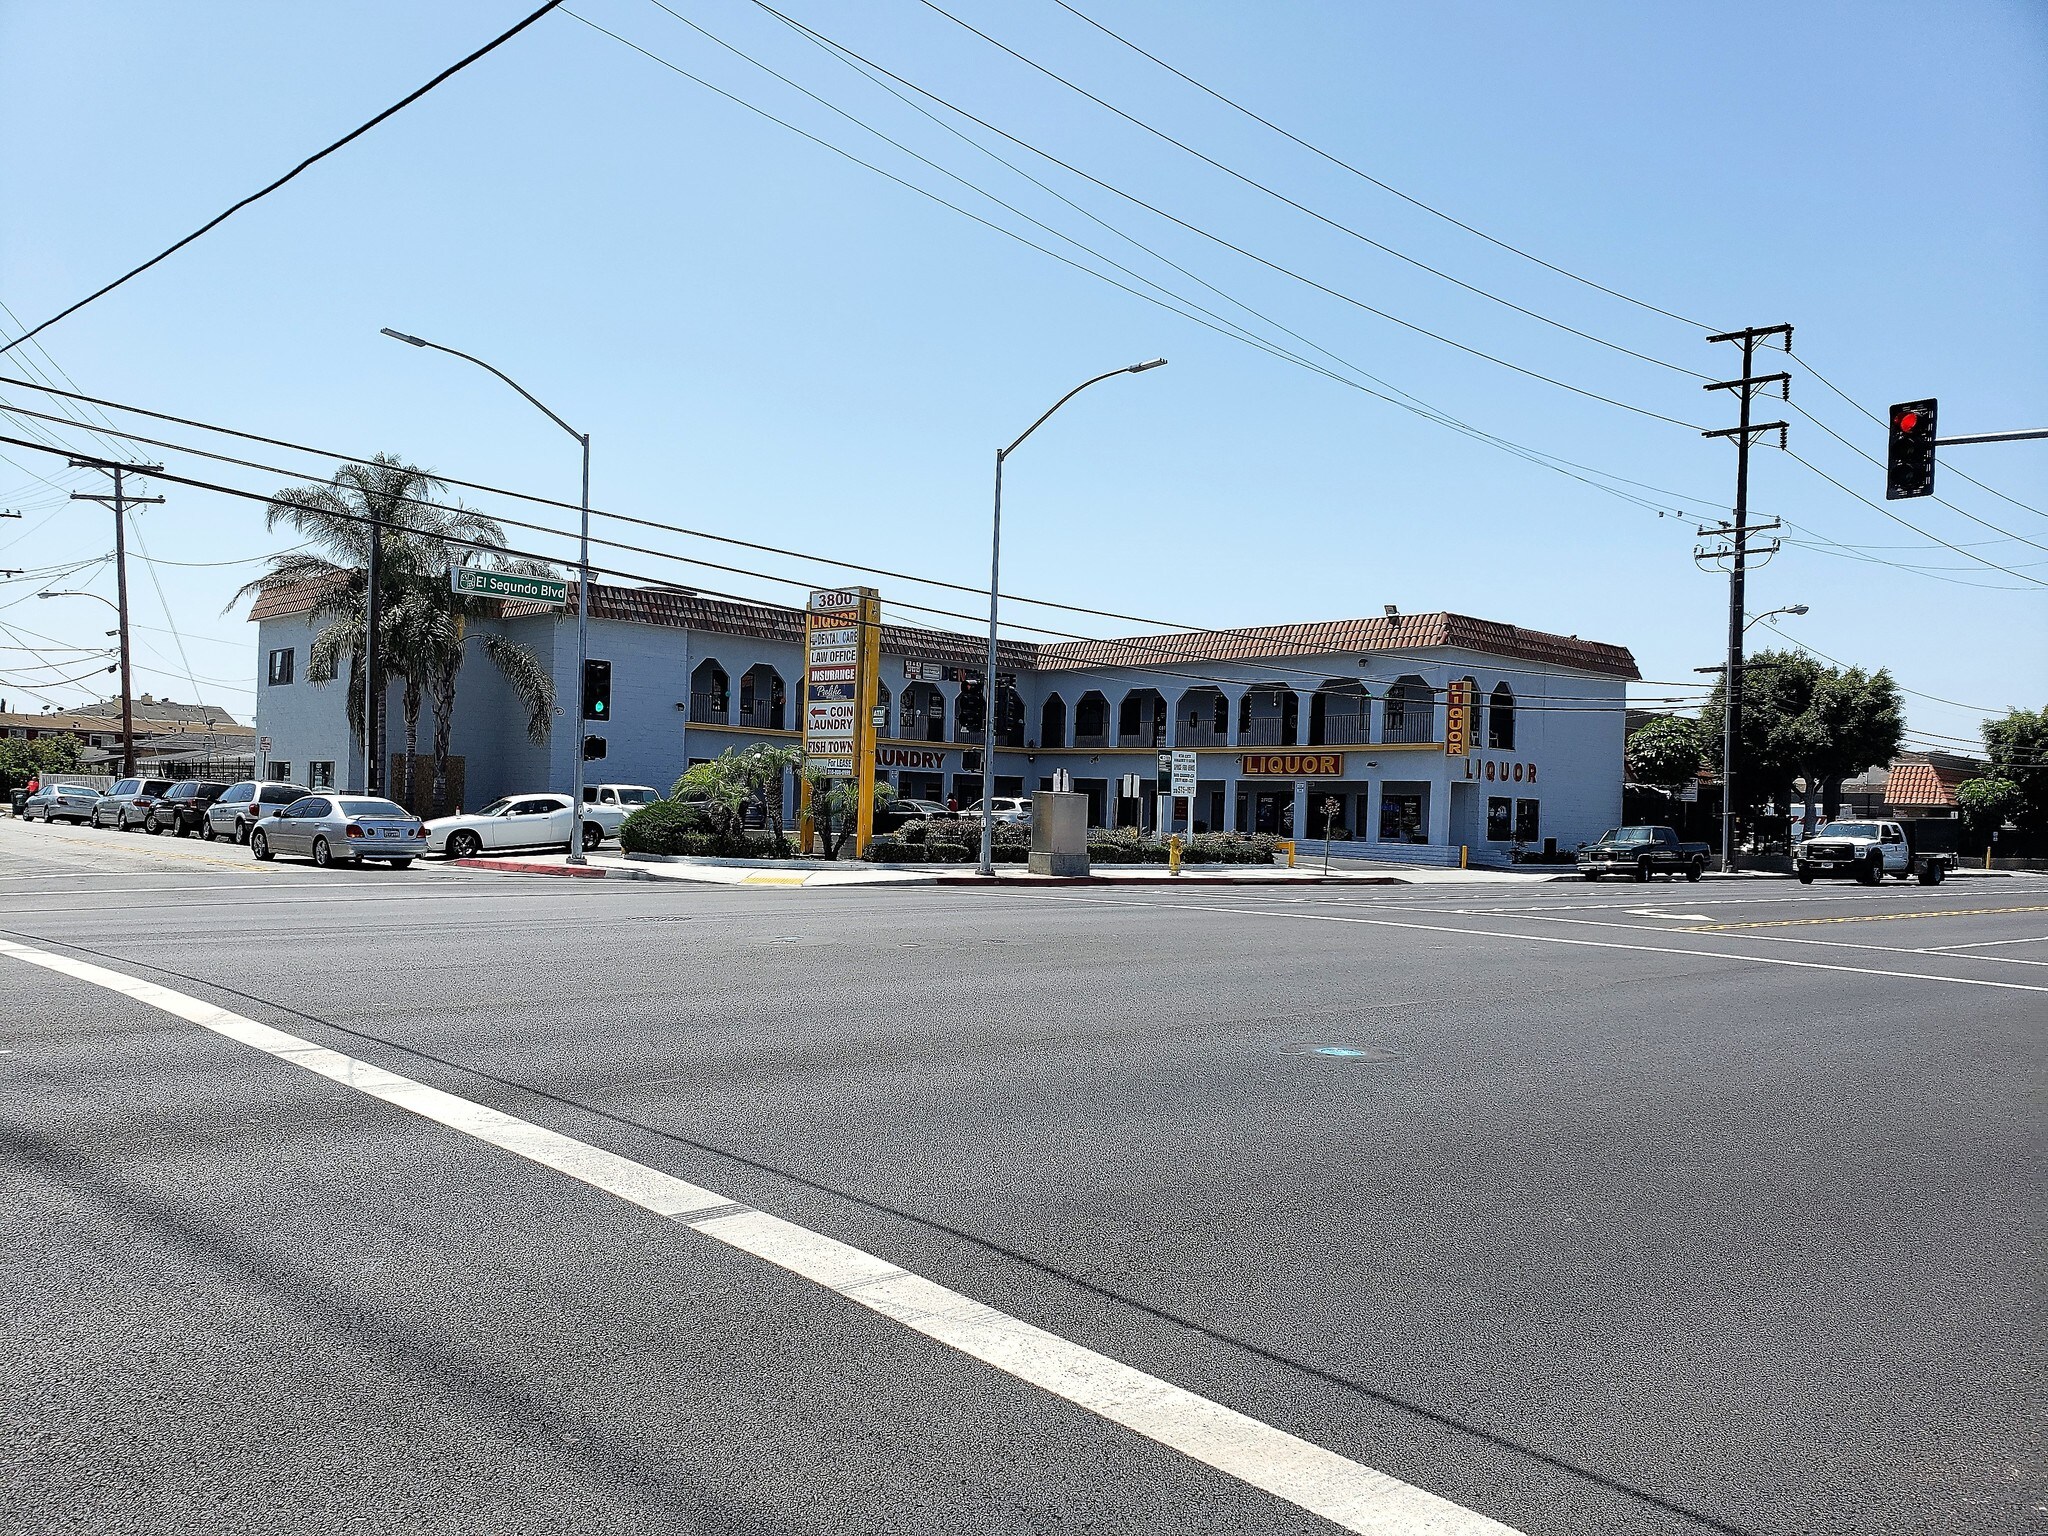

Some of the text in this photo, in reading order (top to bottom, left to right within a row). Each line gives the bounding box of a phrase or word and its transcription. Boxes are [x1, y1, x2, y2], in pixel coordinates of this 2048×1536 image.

[476, 576, 565, 599] El Segundo Blvd
[818, 593, 852, 607] 3800
[811, 611, 857, 629] LIQUOR
[817, 631, 858, 645] DENTAL CARE
[811, 650, 855, 663] LAW OFFICE
[811, 669, 855, 682] INSURANCE
[830, 706, 853, 717] COIN
[808, 719, 853, 730] LAUNDRY
[1448, 684, 1463, 754] LIQUOR
[808, 740, 853, 753] FISH TOWN
[836, 759, 852, 768] LEASE
[876, 749, 946, 768] AUNDRY
[1246, 756, 1335, 774] LIQUOR
[1465, 759, 1537, 783] LIQUOR
